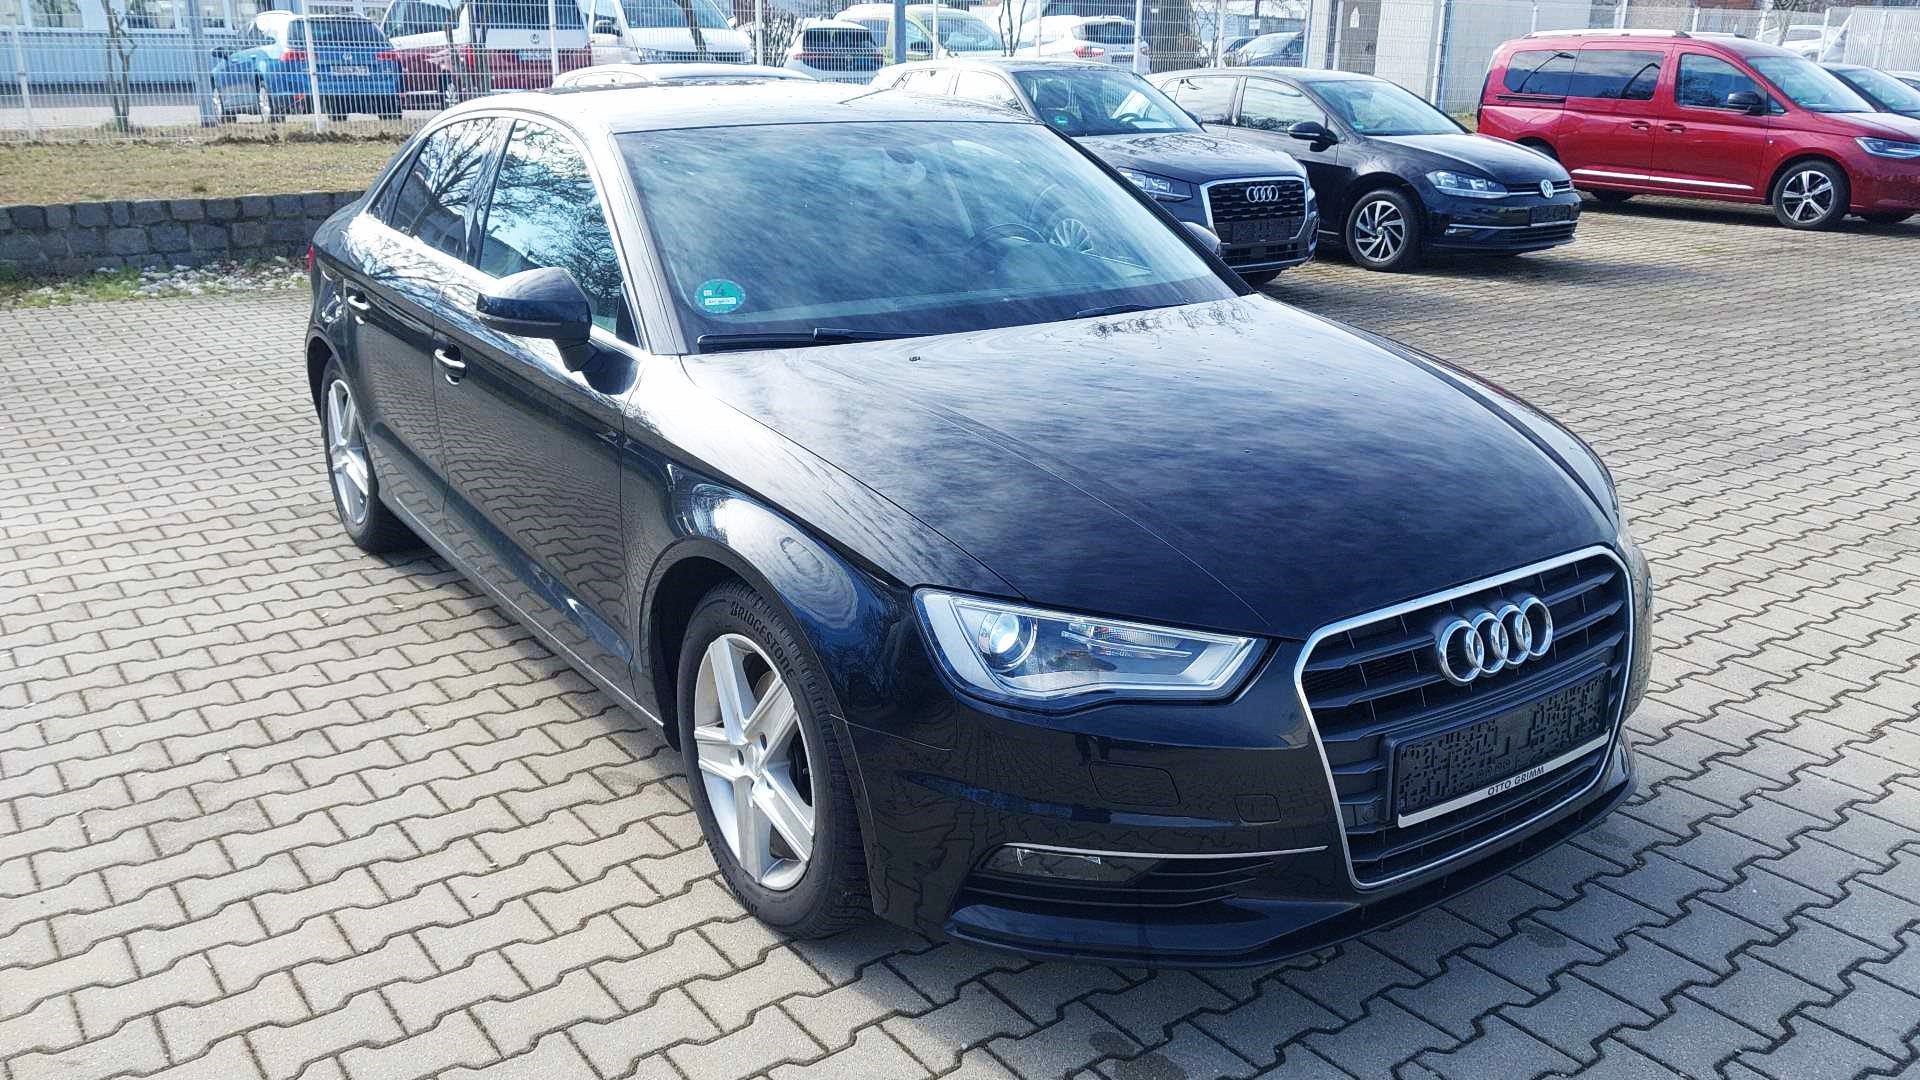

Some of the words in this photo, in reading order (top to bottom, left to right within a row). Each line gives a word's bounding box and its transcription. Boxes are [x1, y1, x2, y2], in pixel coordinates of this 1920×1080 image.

[730, 600, 796, 680] BRIDGESTONE
[1487, 780, 1512, 796] OTTO
[1514, 765, 1545, 785] GRIMM
